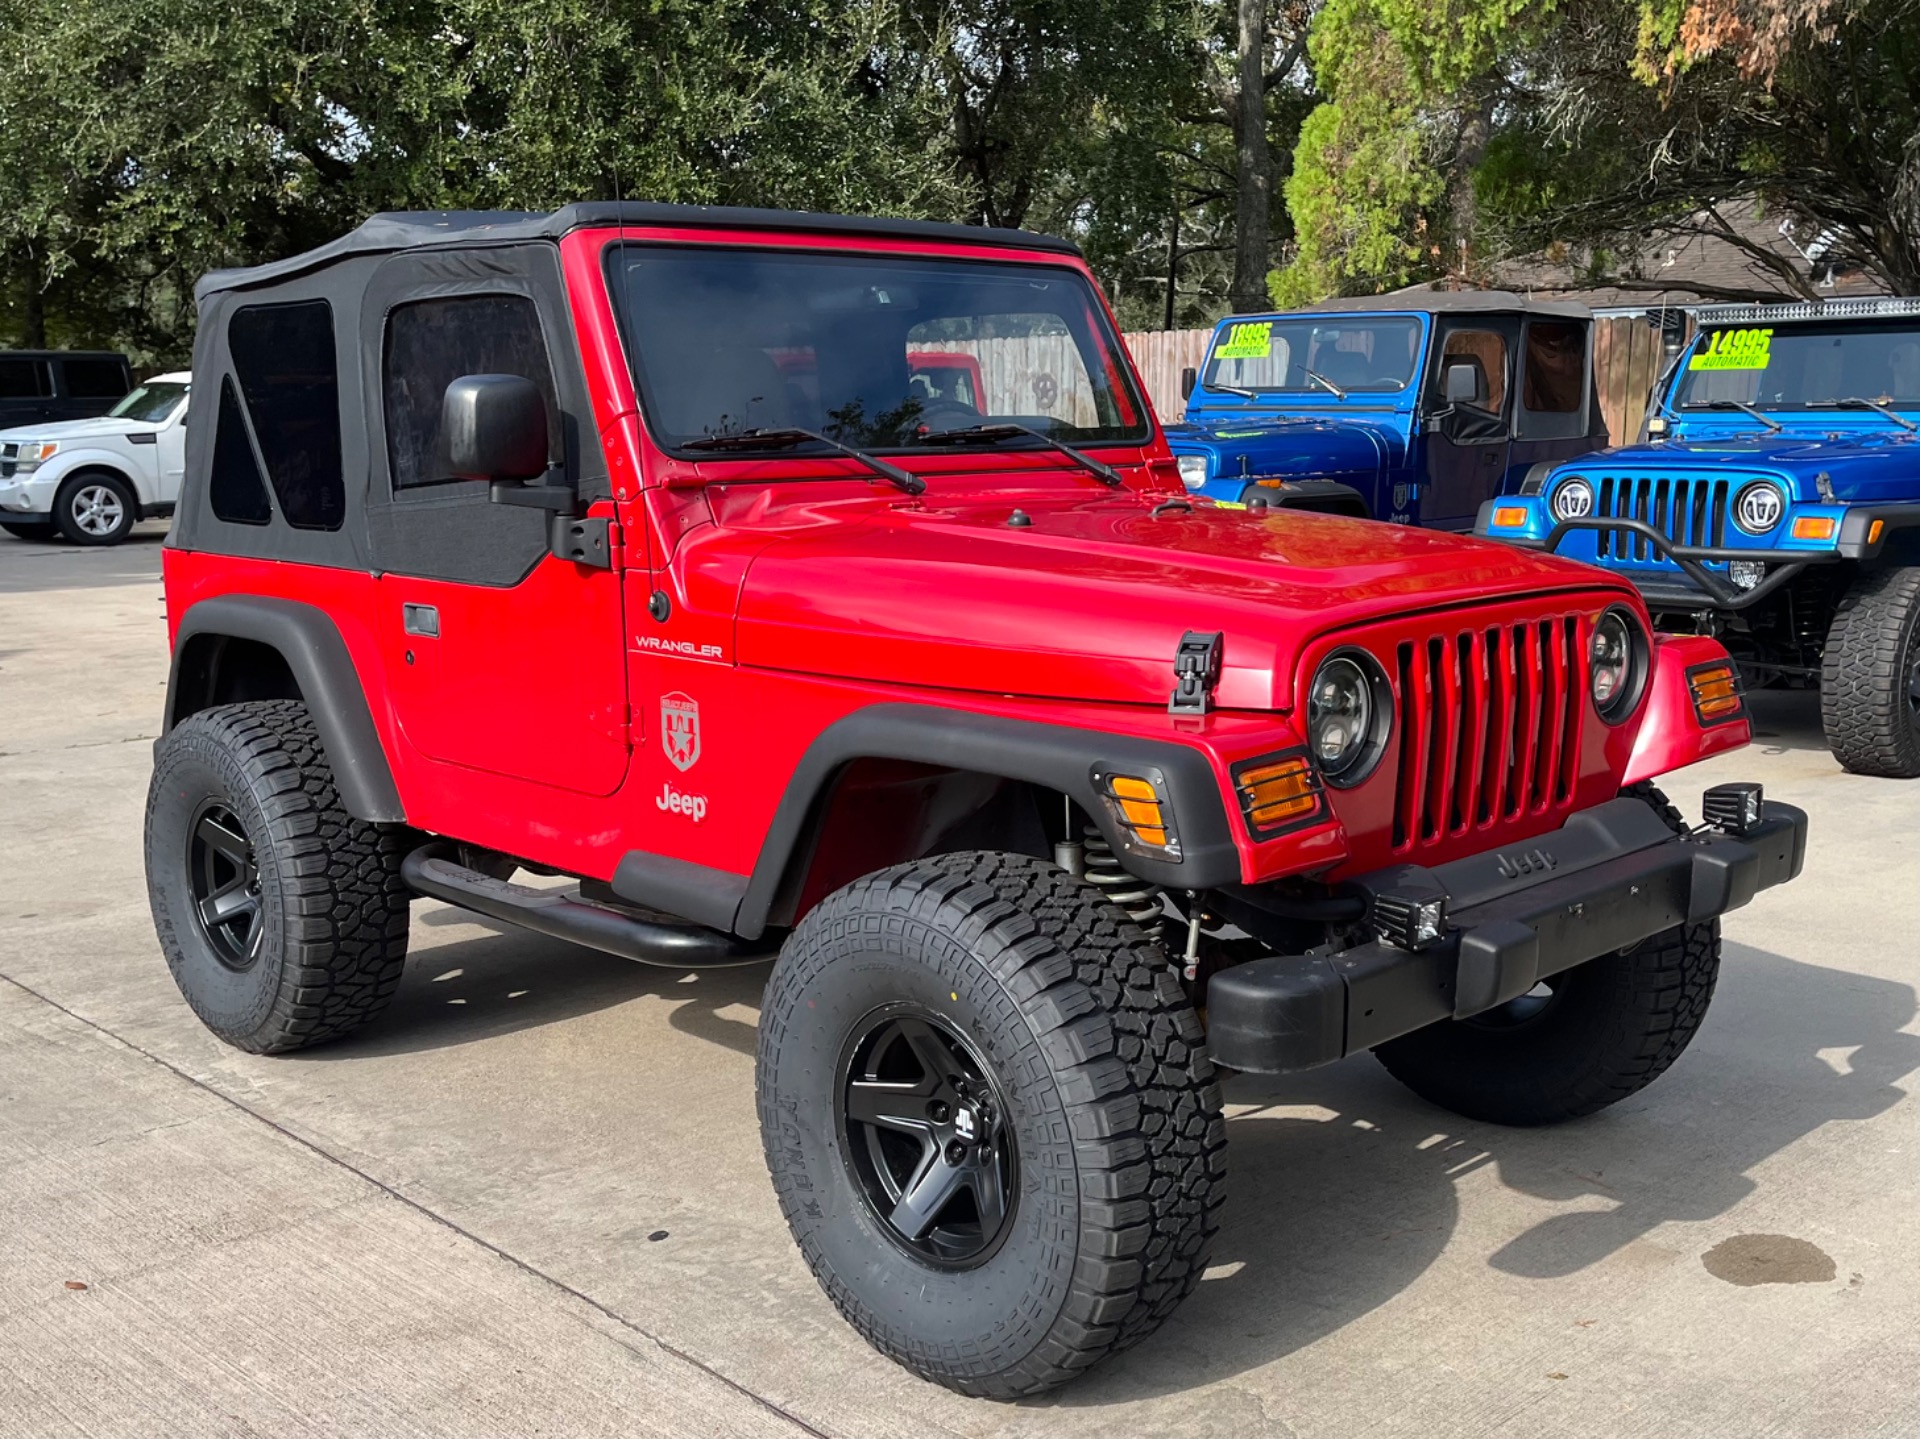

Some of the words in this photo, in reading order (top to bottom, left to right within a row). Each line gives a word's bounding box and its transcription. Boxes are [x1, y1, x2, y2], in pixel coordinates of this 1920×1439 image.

[1228, 322, 1273, 346] 18995
[1706, 329, 1773, 355] 14995
[1223, 346, 1264, 356] AUTOMATIC
[1702, 355, 1760, 367] AUTOMATIC
[635, 636, 722, 658] WRANGLER
[655, 783, 706, 822] Jeep
[1496, 849, 1557, 879] Jeep
[780, 1098, 824, 1219] KENDA
